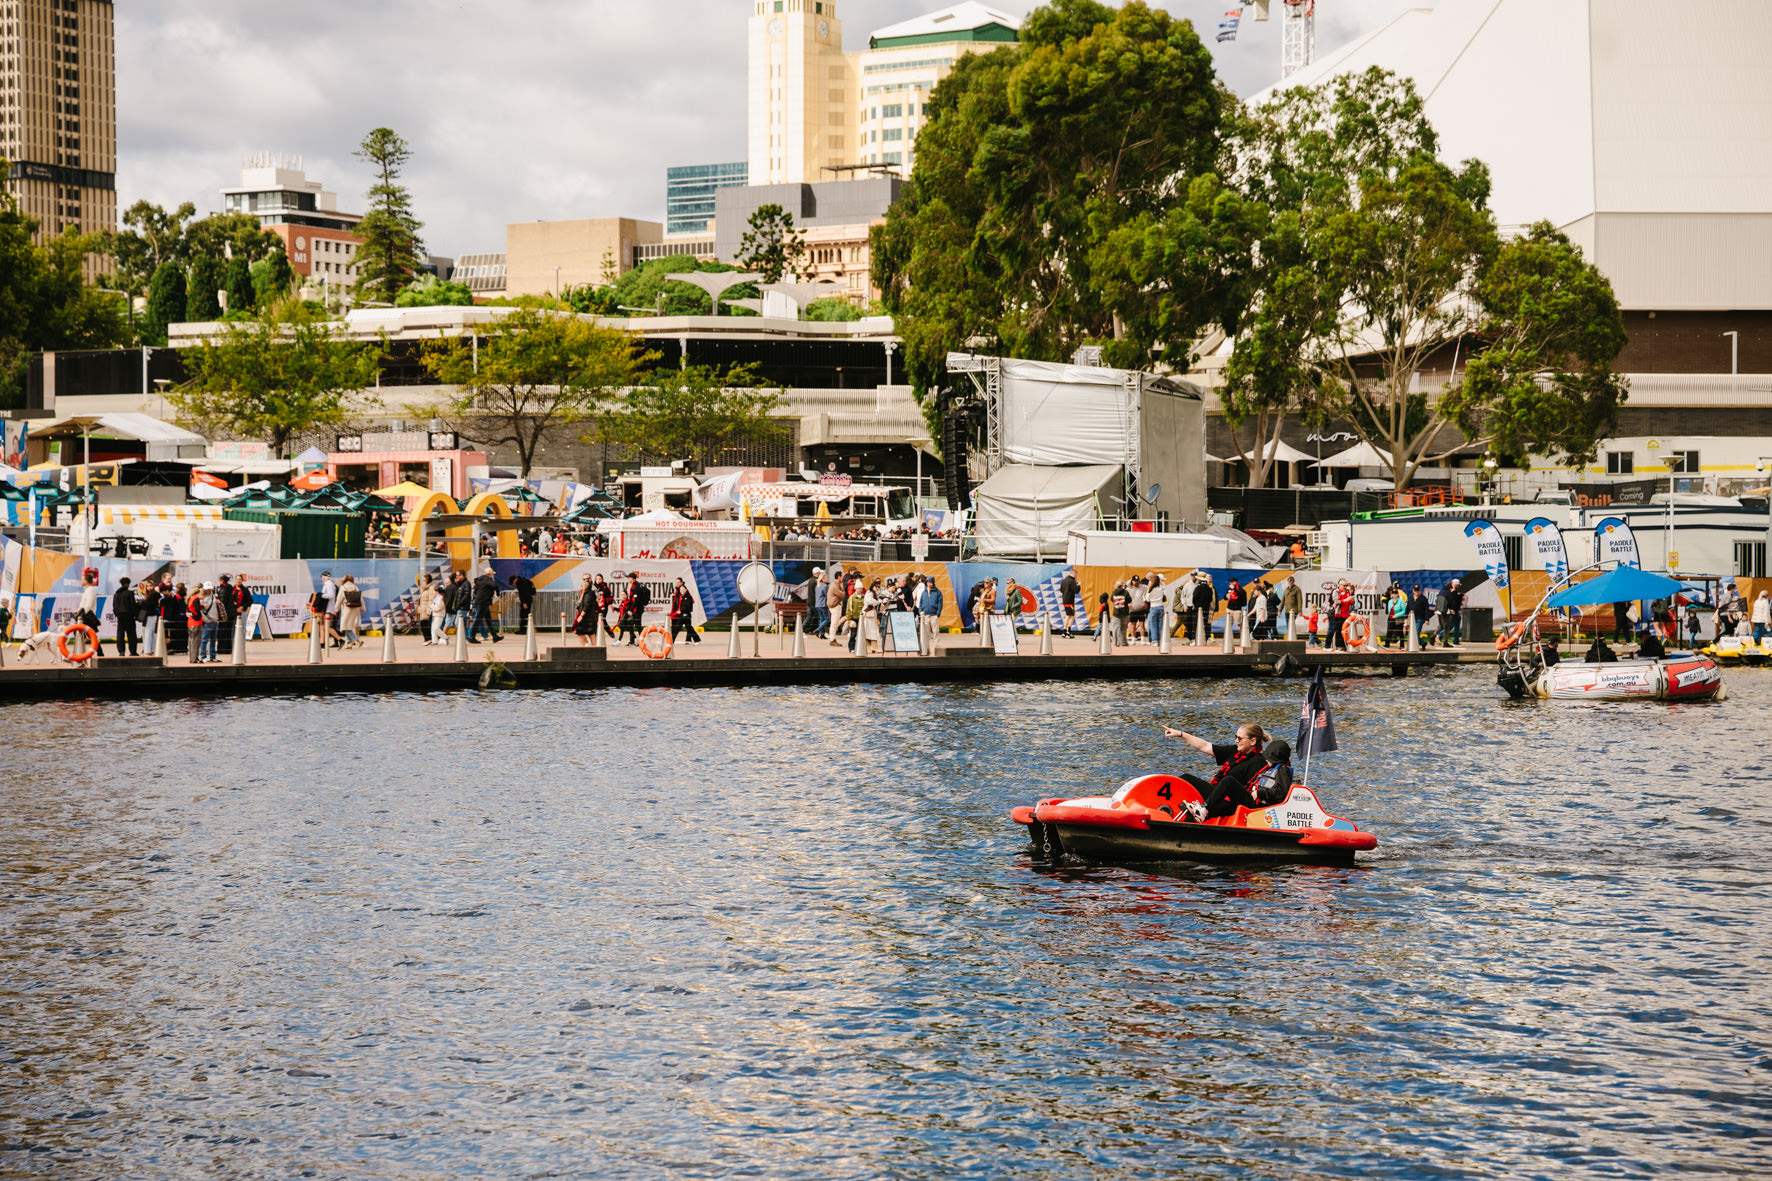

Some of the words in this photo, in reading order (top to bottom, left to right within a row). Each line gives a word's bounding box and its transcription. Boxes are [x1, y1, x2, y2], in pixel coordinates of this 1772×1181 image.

[1578, 494, 1613, 507] Built
[1478, 541, 1501, 549] PADDLE
[1538, 540, 1560, 548] PADDLE
[1610, 540, 1632, 548] PADDLE
[1601, 674, 1639, 682] bbqbuoys
[1158, 782, 1172, 801] 4
[1286, 811, 1313, 821] PADDLE
[1287, 820, 1313, 828] BATTLE
